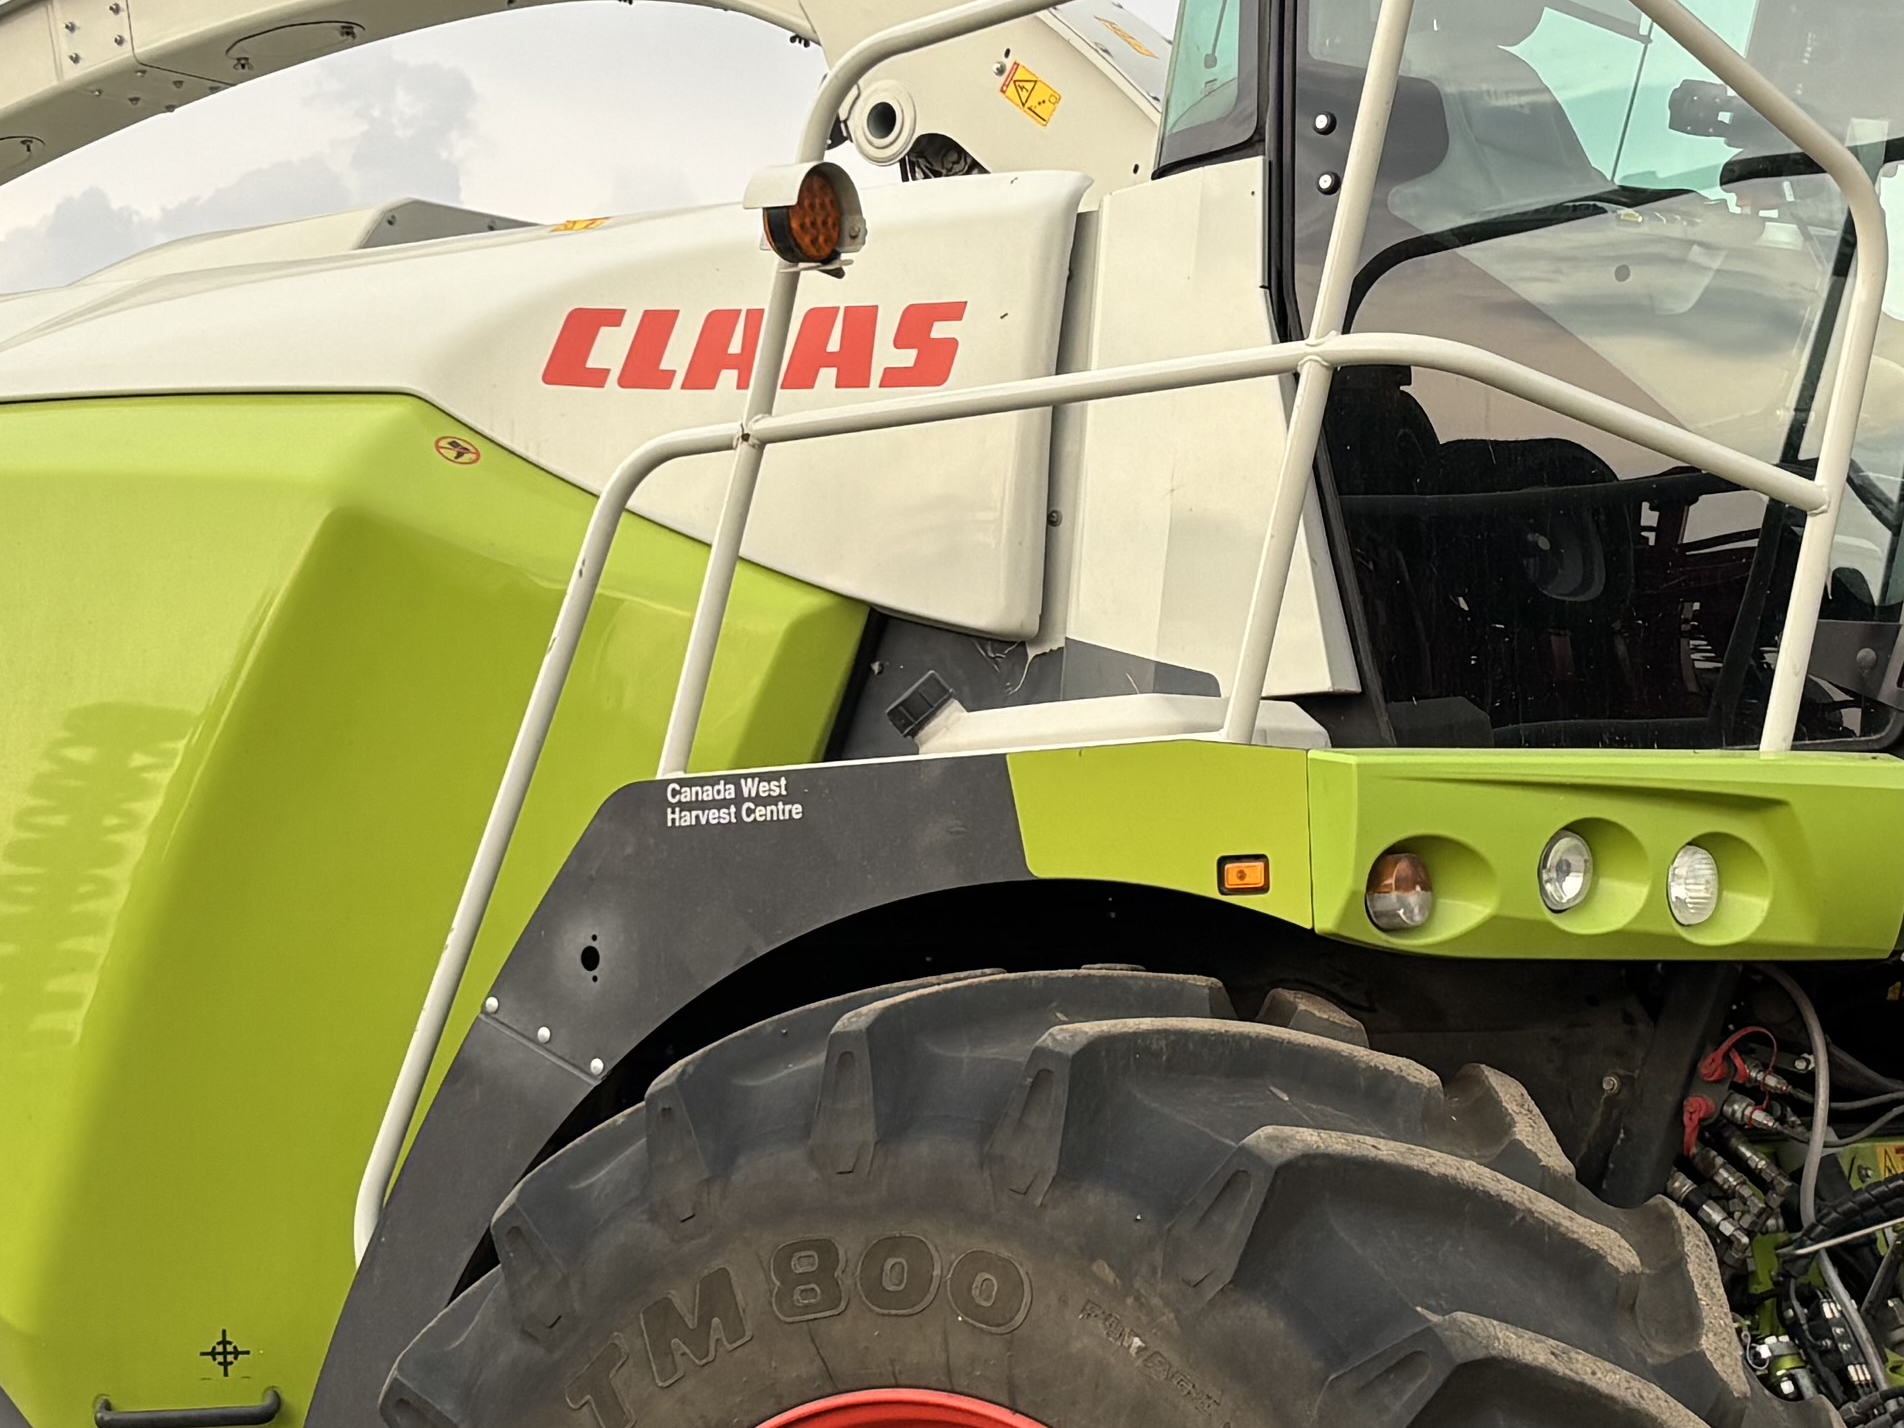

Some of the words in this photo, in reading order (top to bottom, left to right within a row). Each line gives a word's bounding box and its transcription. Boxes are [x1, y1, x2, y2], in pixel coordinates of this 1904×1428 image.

[541, 300, 968, 390] CLAAS
[667, 780, 736, 803] Canada
[740, 776, 787, 798] West
[667, 804, 737, 827] Harvest
[741, 801, 803, 823] Centre
[770, 1233, 1035, 1335] 800
